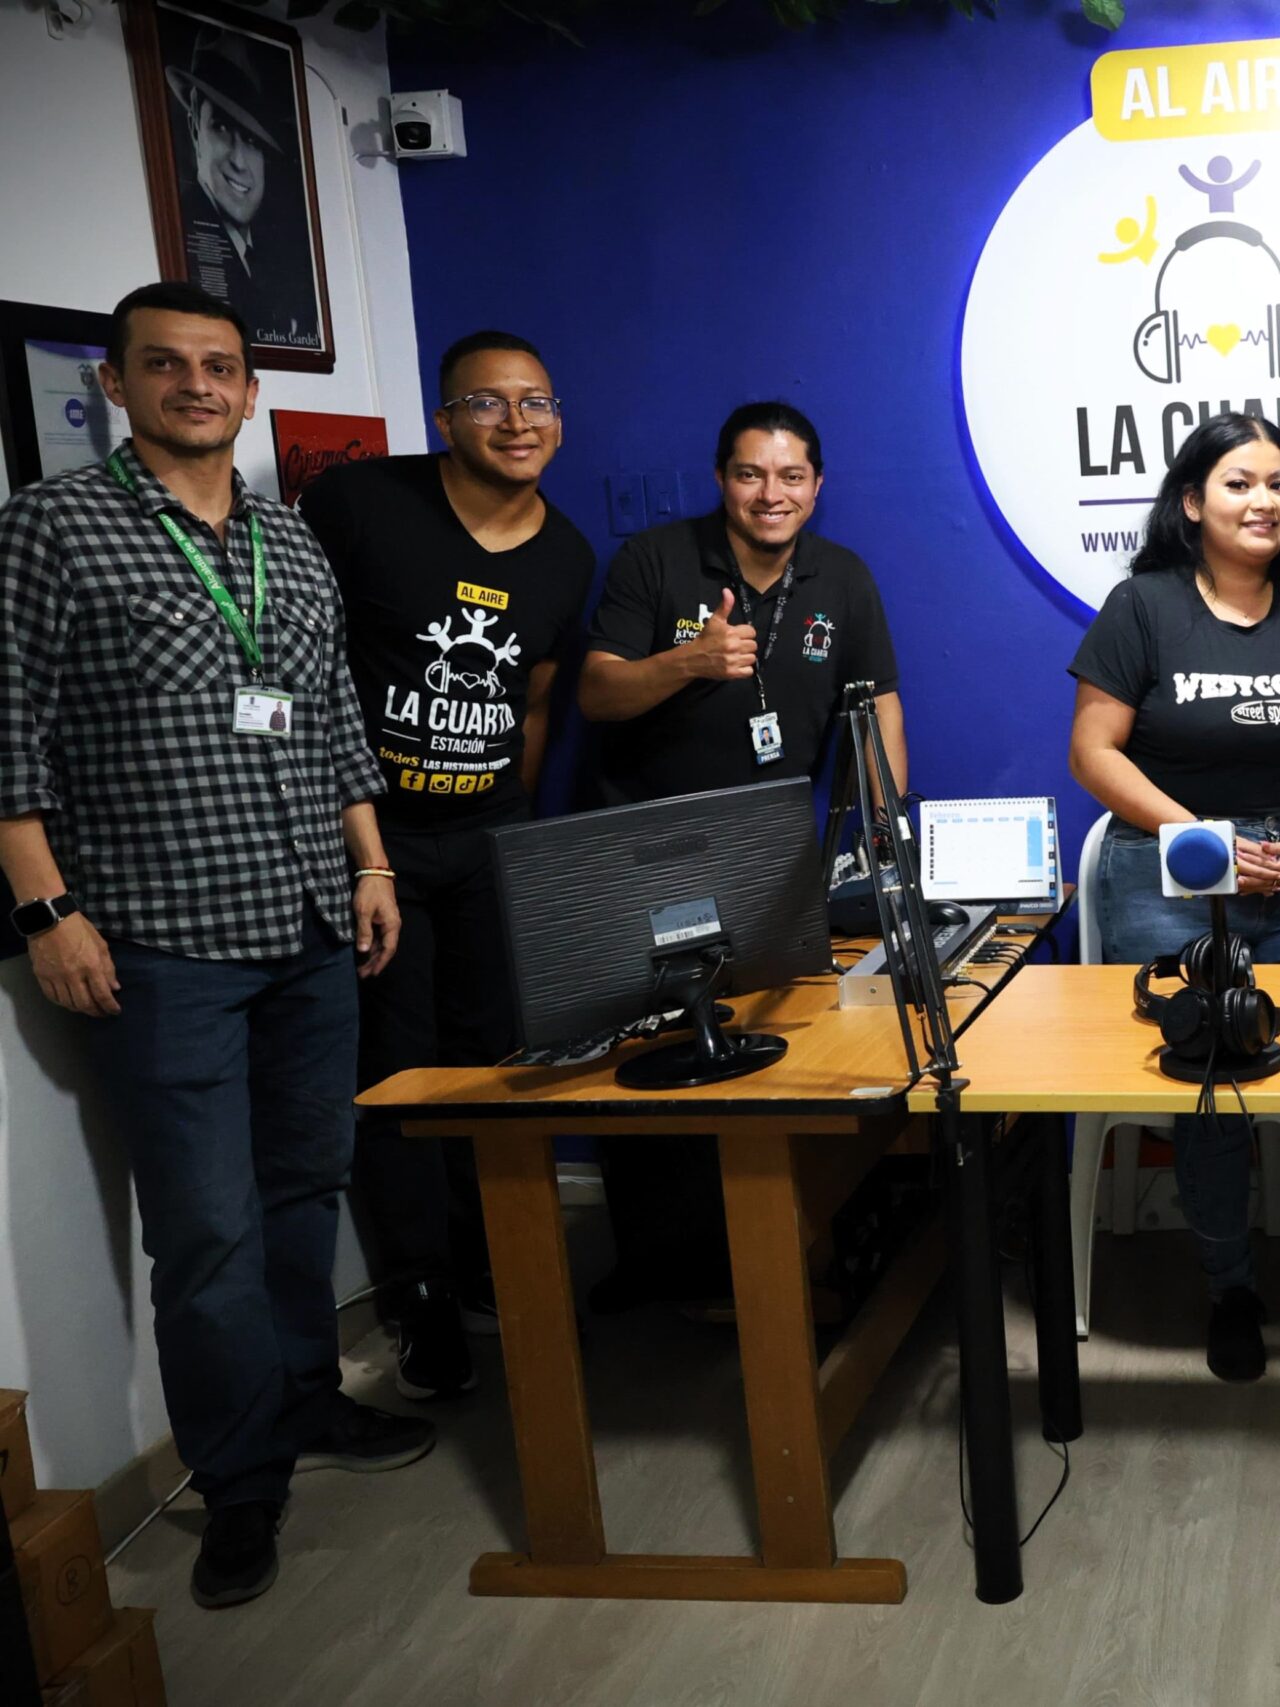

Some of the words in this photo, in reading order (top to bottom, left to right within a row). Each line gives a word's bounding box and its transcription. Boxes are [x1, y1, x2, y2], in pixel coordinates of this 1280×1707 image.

[1120, 65, 1187, 120] AL
[256, 328, 287, 343] Carlos
[288, 331, 319, 346] Gardel
[1076, 403, 1147, 477] LA
[185, 541, 198, 554] de
[459, 585, 475, 599] AL
[478, 591, 505, 606] AIRE
[384, 685, 420, 727] LA
[428, 697, 516, 735] CUARTA
[1237, 701, 1266, 721] street
[430, 735, 486, 754] ESTACIÓN
[378, 746, 420, 767] todas
[423, 759, 441, 770] LAS
[442, 760, 488, 772] HISTORIAS
